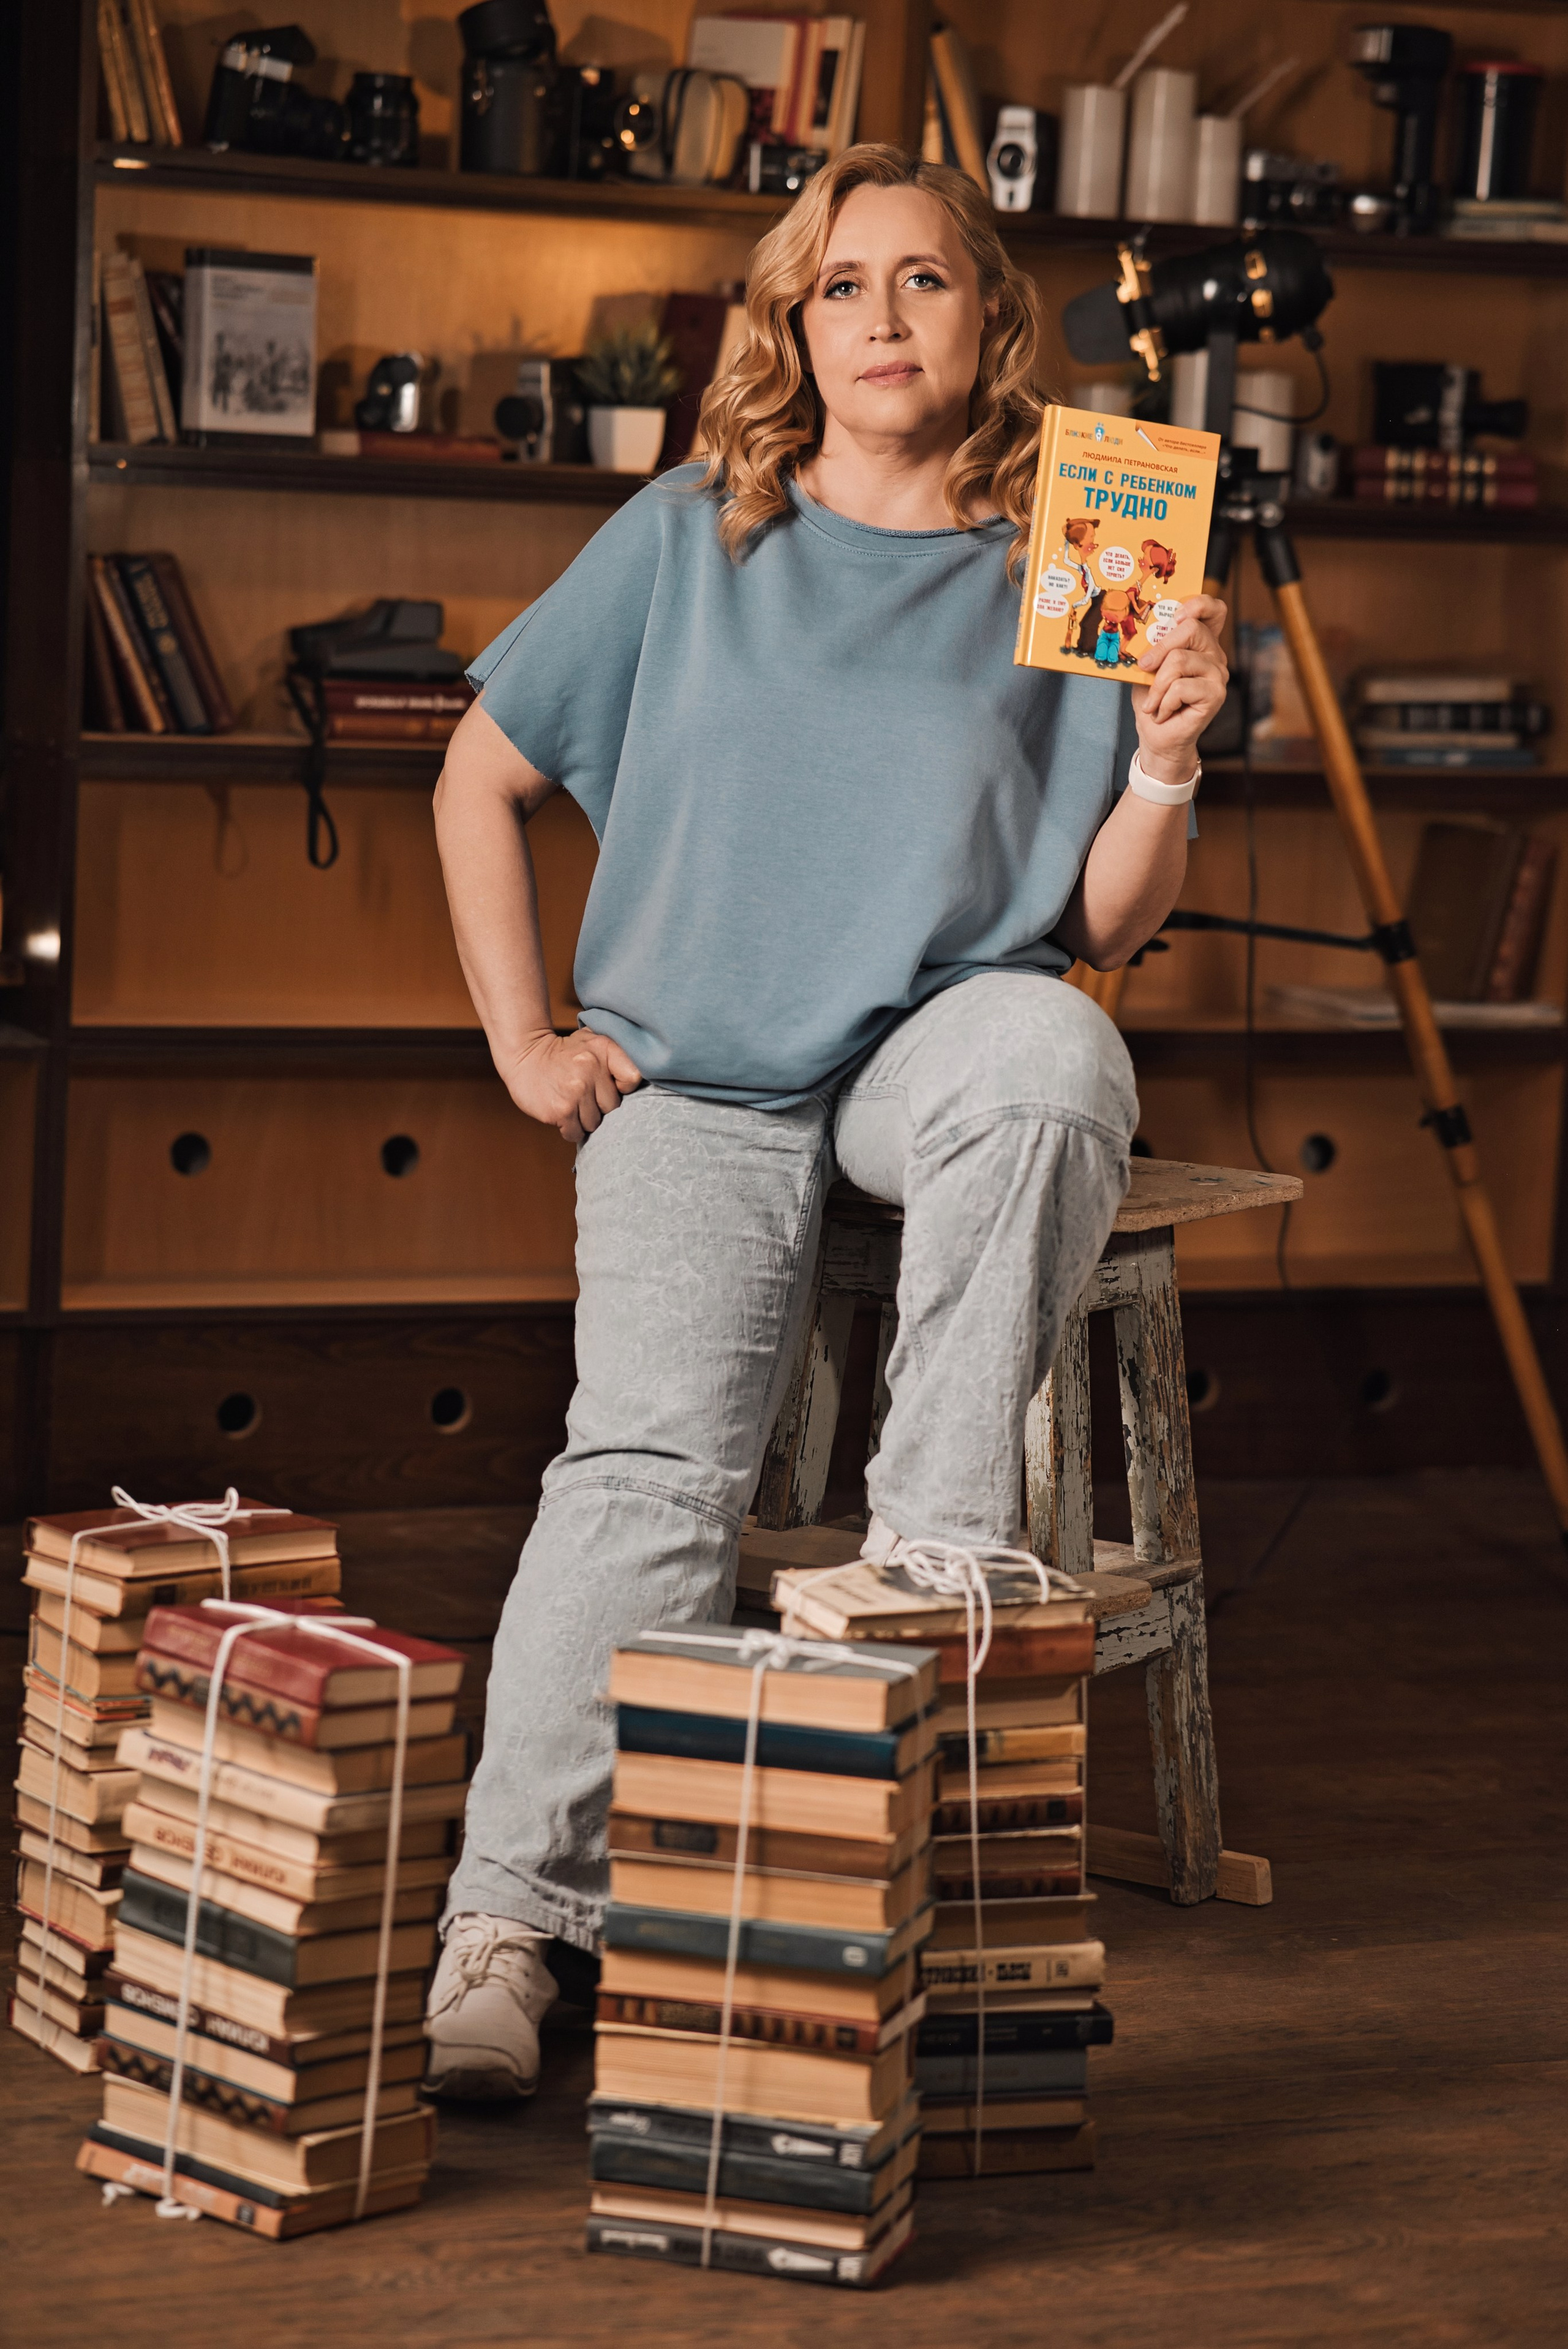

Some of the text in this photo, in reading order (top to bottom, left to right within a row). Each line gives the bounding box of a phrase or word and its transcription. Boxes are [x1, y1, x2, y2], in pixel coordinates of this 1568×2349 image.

[1065, 429, 1123, 445] БЛИЗКИЕ ЛЮДИ
[1082, 451, 1178, 473] ЛЮДМИЛА ПЕТРАНОВСКАЯ
[1059, 463, 1197, 499] ЕСЛИ С РЕБЕНКОМ
[1084, 487, 1167, 521] ТРУДНО
